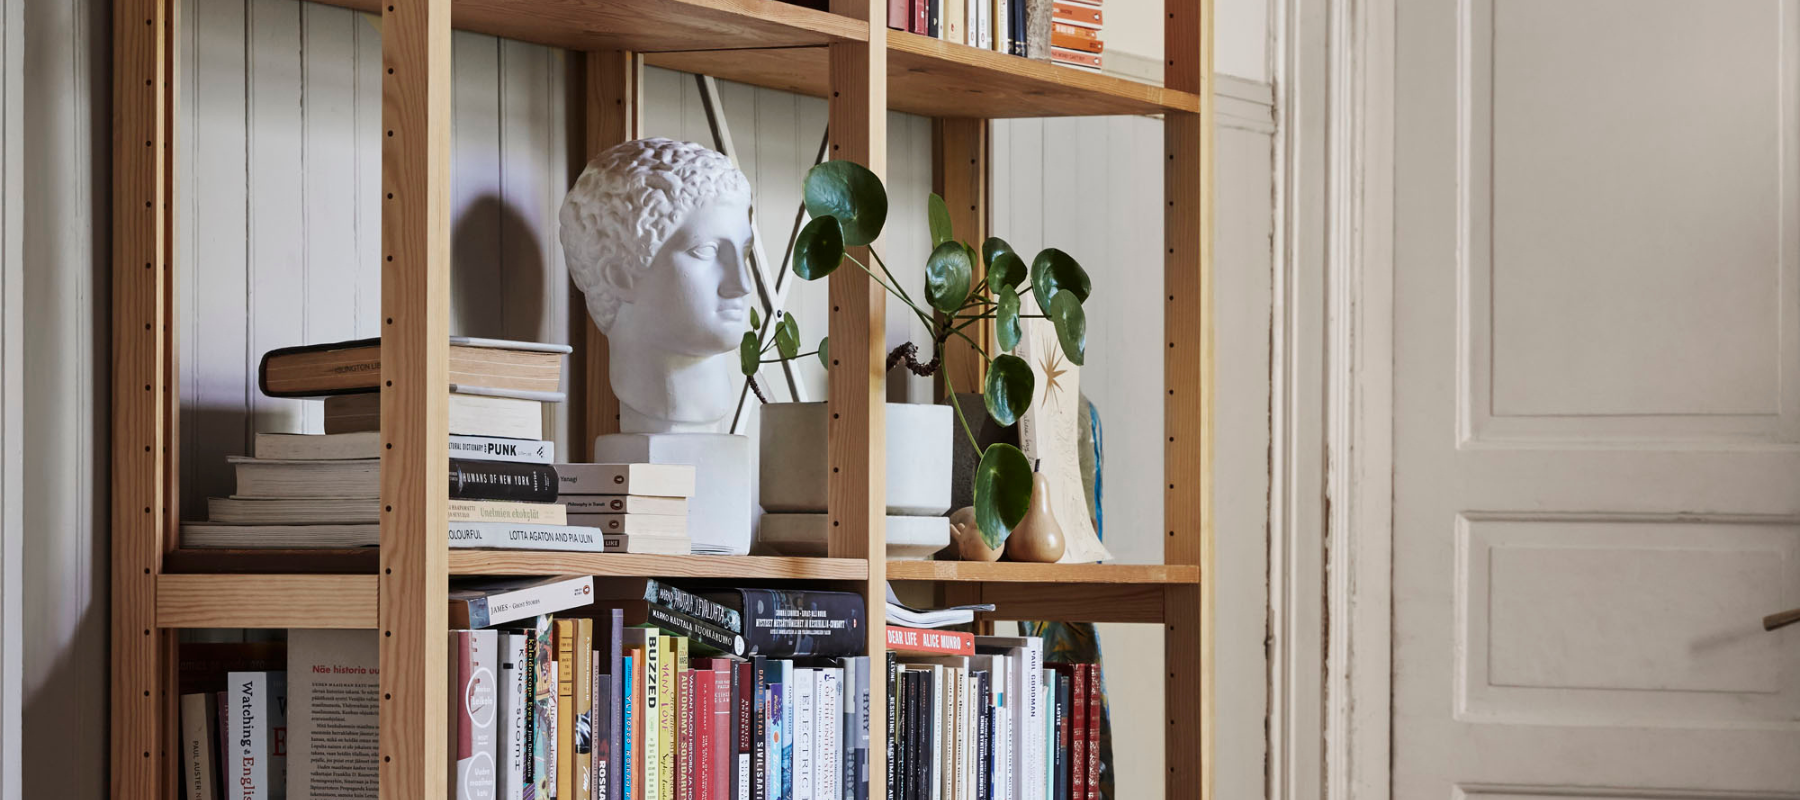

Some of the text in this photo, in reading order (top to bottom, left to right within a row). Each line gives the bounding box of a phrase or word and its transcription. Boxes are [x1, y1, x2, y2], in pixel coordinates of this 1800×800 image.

[488, 442, 517, 456] PUNK
[462, 473, 488, 484] HUMANS
[490, 474, 497, 484] OF
[499, 474, 512, 485] NEW
[514, 475, 530, 486] YORK
[560, 476, 578, 484] Yanagi
[449, 529, 482, 540] OLOURFUL
[509, 530, 594, 544] LOTTA AGATON AND PIA ULIN
[491, 604, 509, 615] JAMES
[652, 609, 670, 622] MARKO
[669, 615, 693, 631] HAUTALA
[887, 629, 961, 650] DEAR LIFE ALICE MUNRO
[312, 665, 331, 674] Näe
[333, 665, 367, 674] historia
[648, 636, 657, 708] BUZZED
[661, 664, 669, 696] MANY
[240, 680, 255, 747] Watching
[526, 701, 534, 721] Eyes
[660, 702, 669, 733] LOVE
[862, 693, 870, 732] HYRY
[192, 740, 200, 760] PAUL
[802, 694, 811, 789] ELECTRIC
[526, 743, 534, 778] DeRogatis
[194, 761, 203, 791] AUSTER
[598, 759, 607, 800] ROSKA
[688, 776, 692, 786] JA
[847, 751, 855, 794] HYRY
